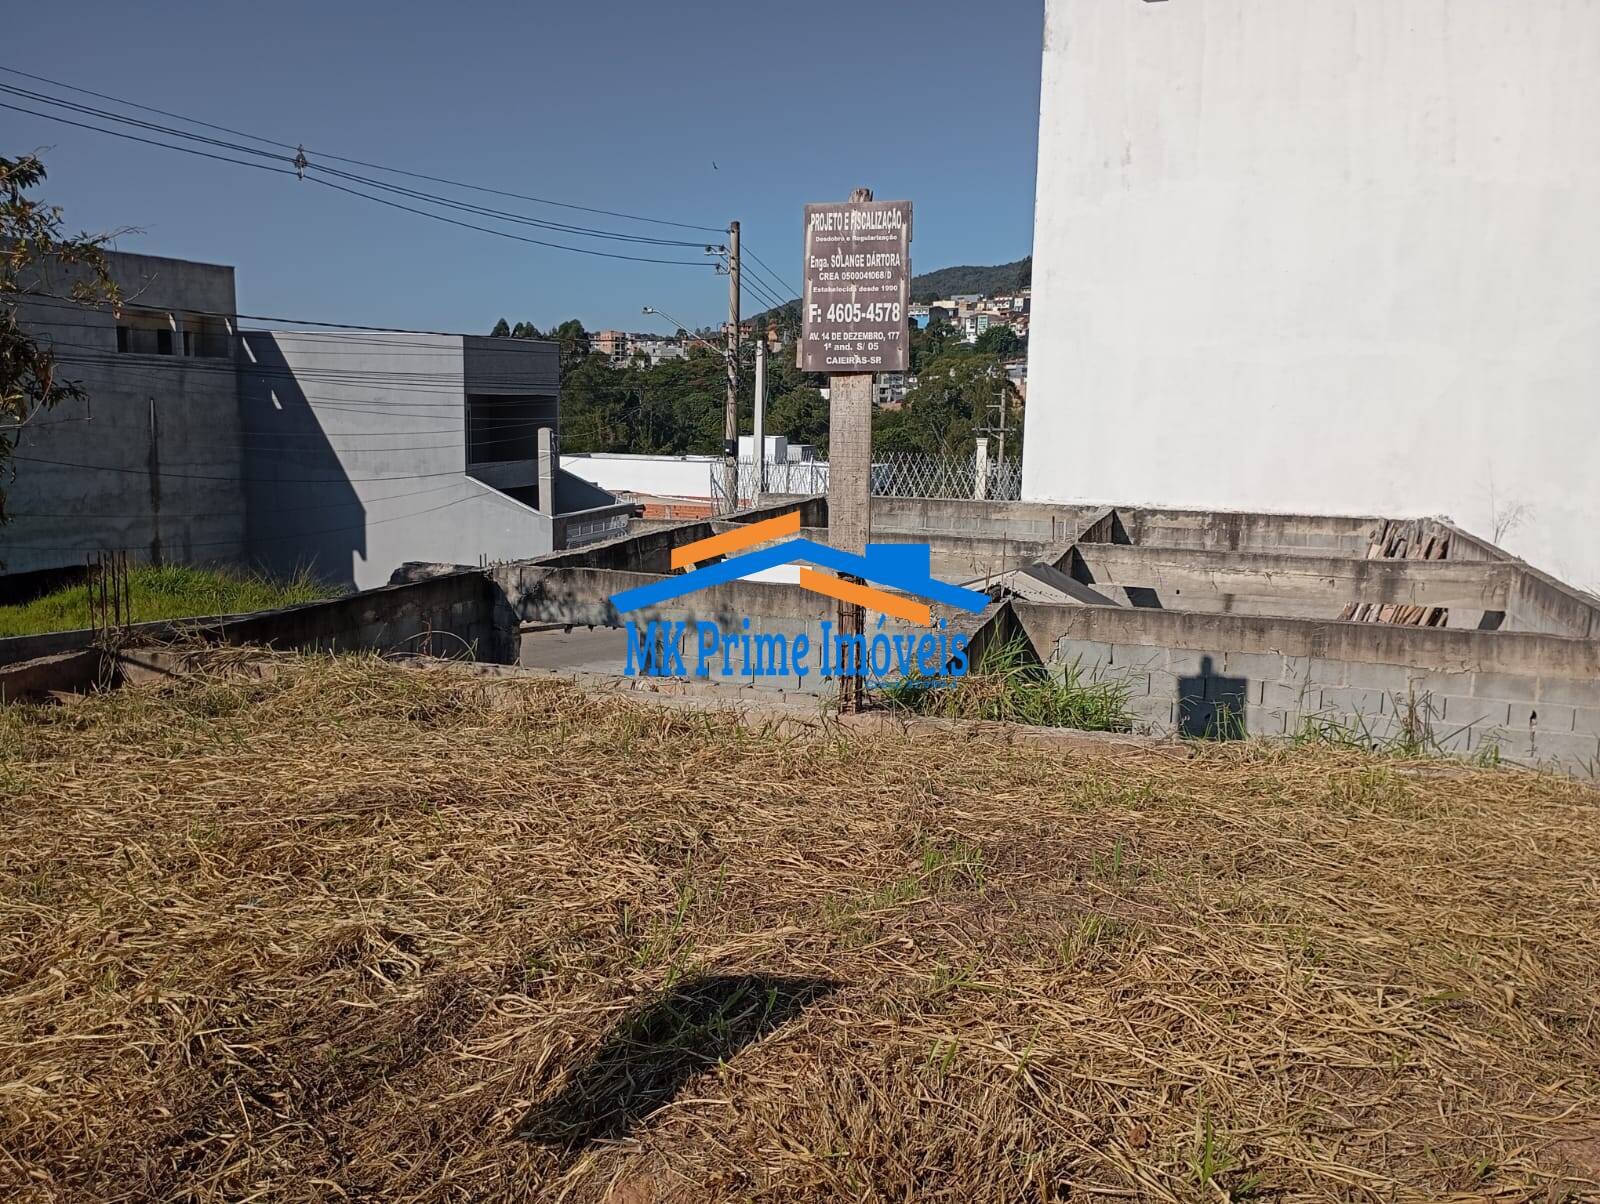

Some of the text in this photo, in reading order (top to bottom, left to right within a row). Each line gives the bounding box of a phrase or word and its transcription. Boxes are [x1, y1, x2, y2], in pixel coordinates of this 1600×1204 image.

[811, 208, 902, 233] PROJETO E FISCALIZAÇÃO
[810, 255, 829, 271] Enga.
[831, 254, 864, 267] SOLANGE
[819, 272, 839, 280] CREA
[808, 303, 900, 323] F: 4605-4578
[809, 332, 899, 341] AV. 14 DE DEZEMBRO, 177
[834, 343, 853, 351] and.
